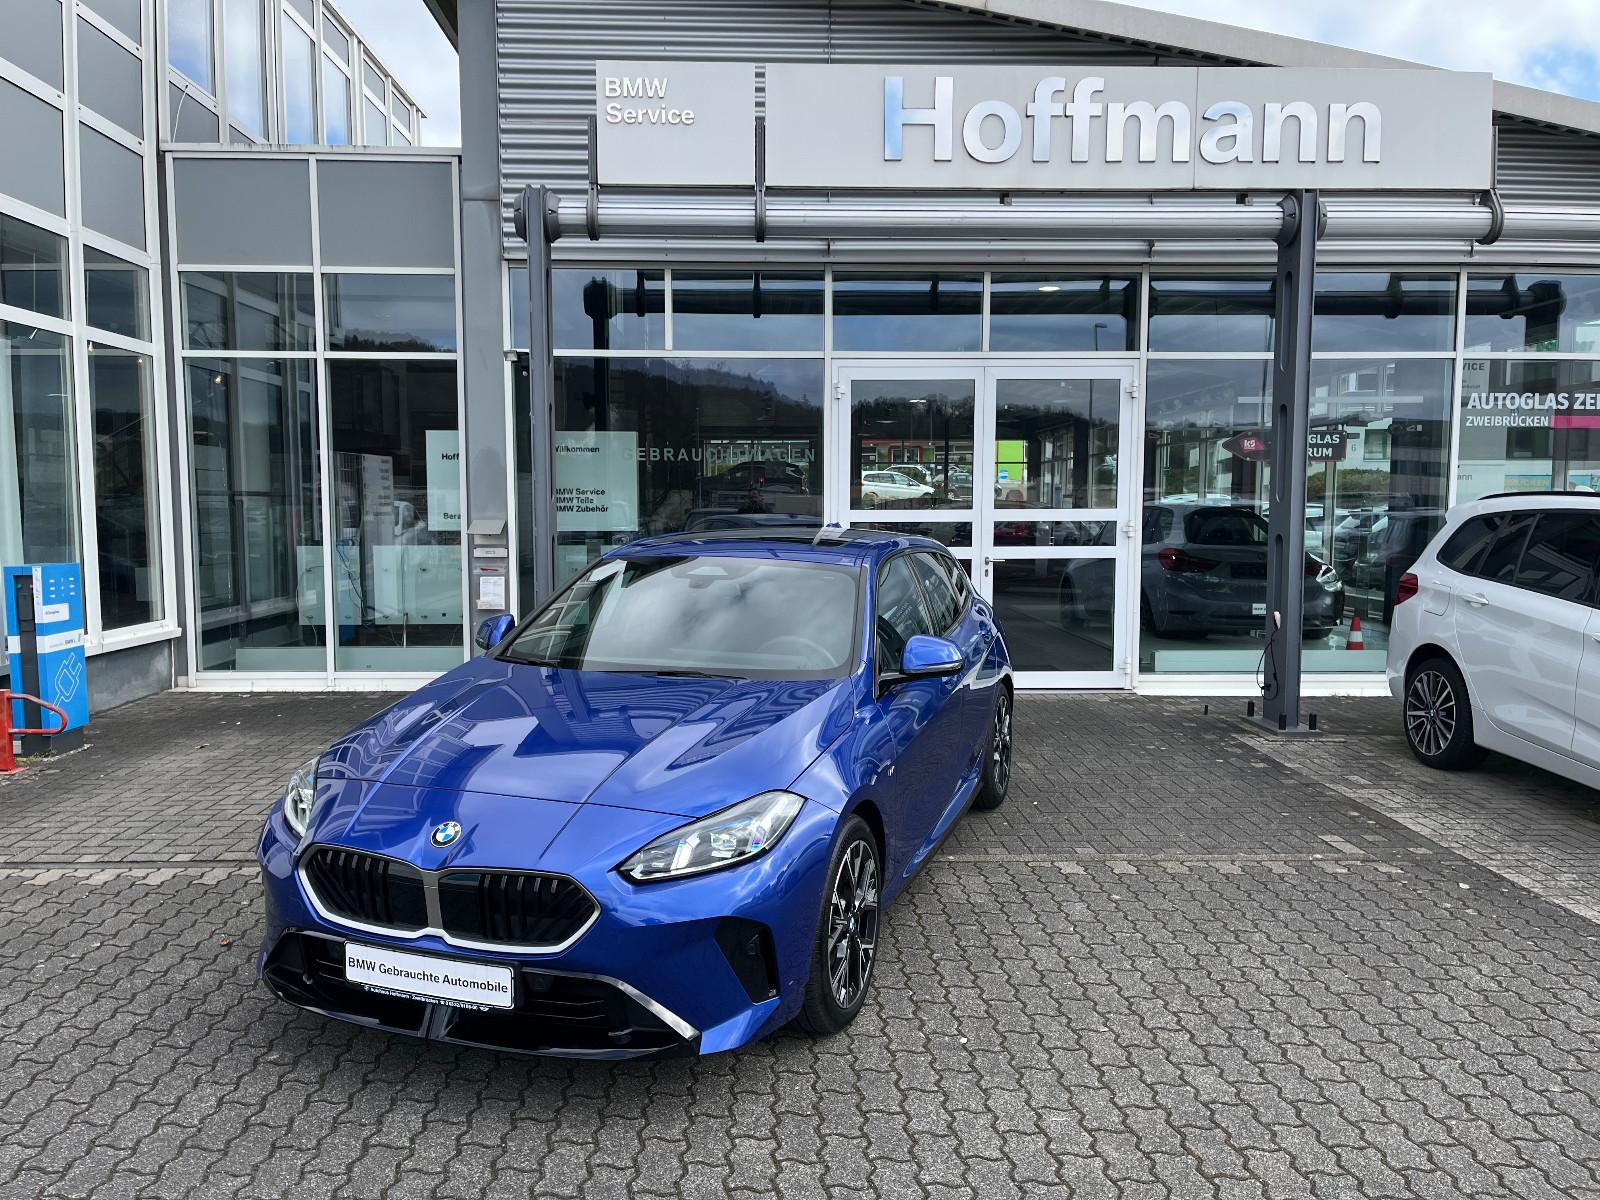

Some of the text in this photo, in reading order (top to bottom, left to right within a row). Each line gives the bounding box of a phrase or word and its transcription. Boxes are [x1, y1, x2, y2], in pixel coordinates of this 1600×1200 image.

[605, 77, 668, 98] BMW
[606, 102, 695, 125] Service
[884, 76, 1383, 164] Hoffmann
[1467, 392, 1570, 410] AUTOGLAS
[1465, 413, 1549, 427] ZWEIBRÜCKEN
[1308, 434, 1340, 444] GLAS
[575, 488, 606, 496] Service
[576, 505, 609, 513] Zubehör
[348, 956, 508, 993] BMW Gebrauchte Automobile
